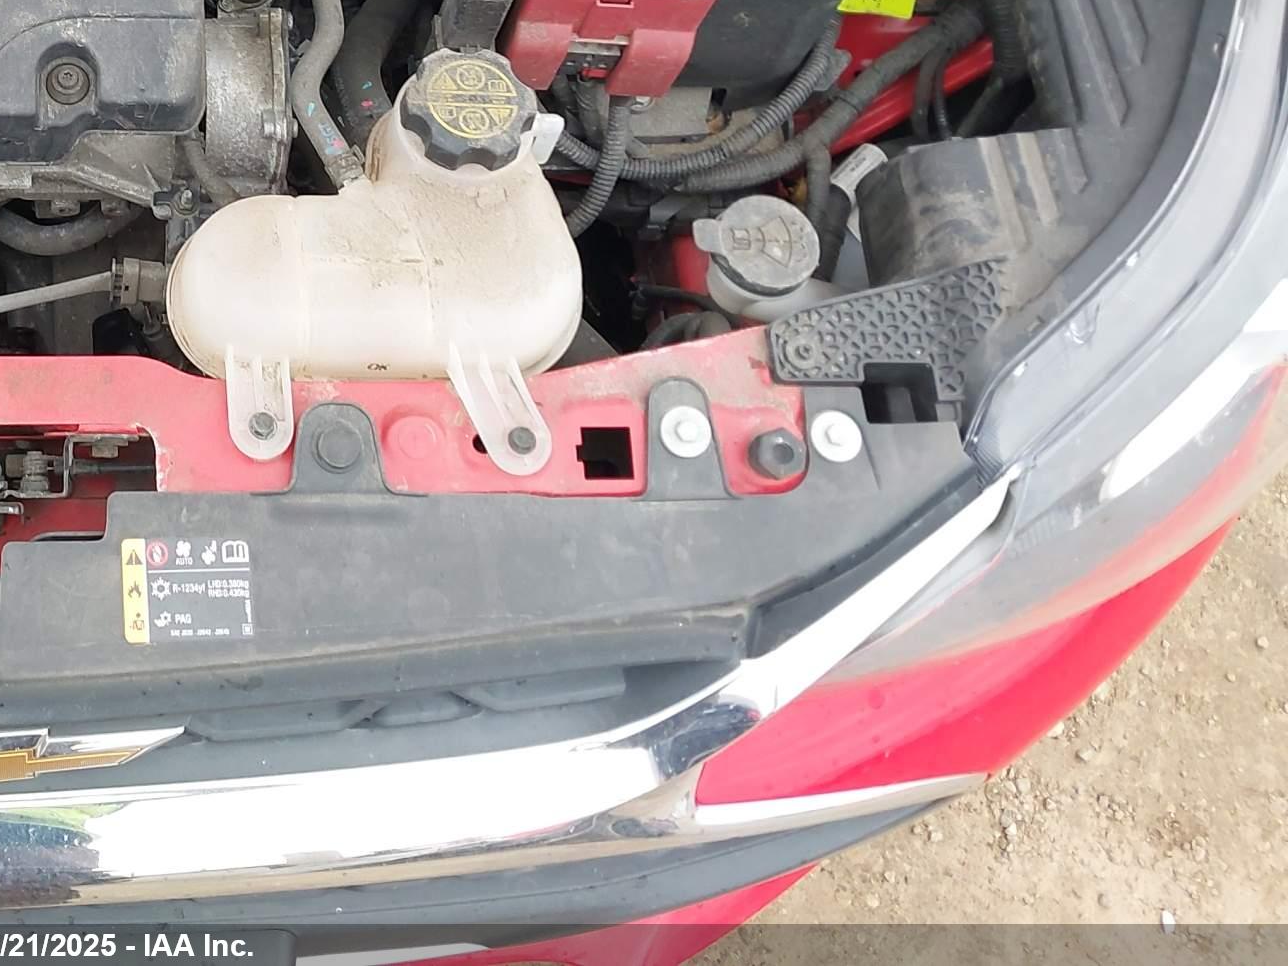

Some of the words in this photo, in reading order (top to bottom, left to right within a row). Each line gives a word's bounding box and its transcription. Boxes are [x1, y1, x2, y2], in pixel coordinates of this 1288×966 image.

[176, 557, 192, 565] AUTO
[172, 583, 206, 594] R-1234yf
[175, 614, 192, 624] PAG
